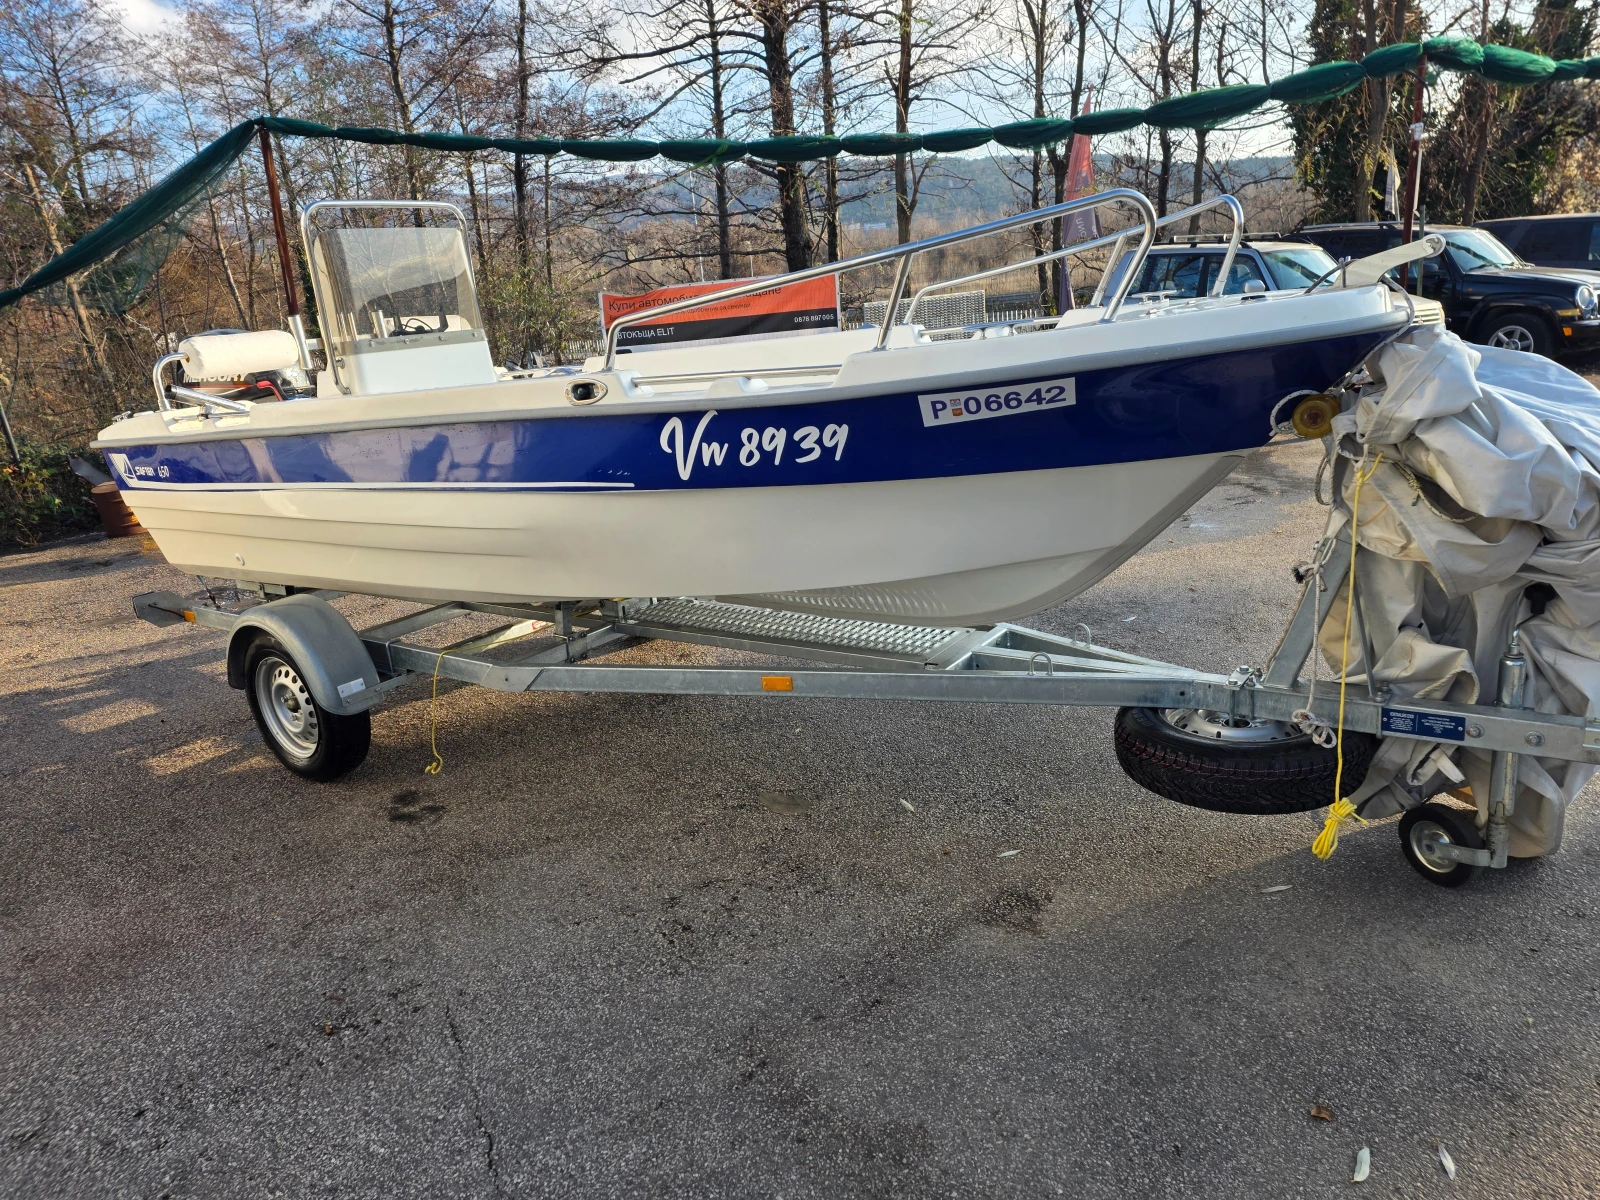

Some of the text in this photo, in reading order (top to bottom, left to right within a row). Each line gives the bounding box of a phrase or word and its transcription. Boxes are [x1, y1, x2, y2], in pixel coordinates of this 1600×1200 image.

[608, 301, 636, 312] Купи
[617, 327, 675, 340] ВТОКЪЩА ELIT
[930, 385, 1067, 419] P 06642
